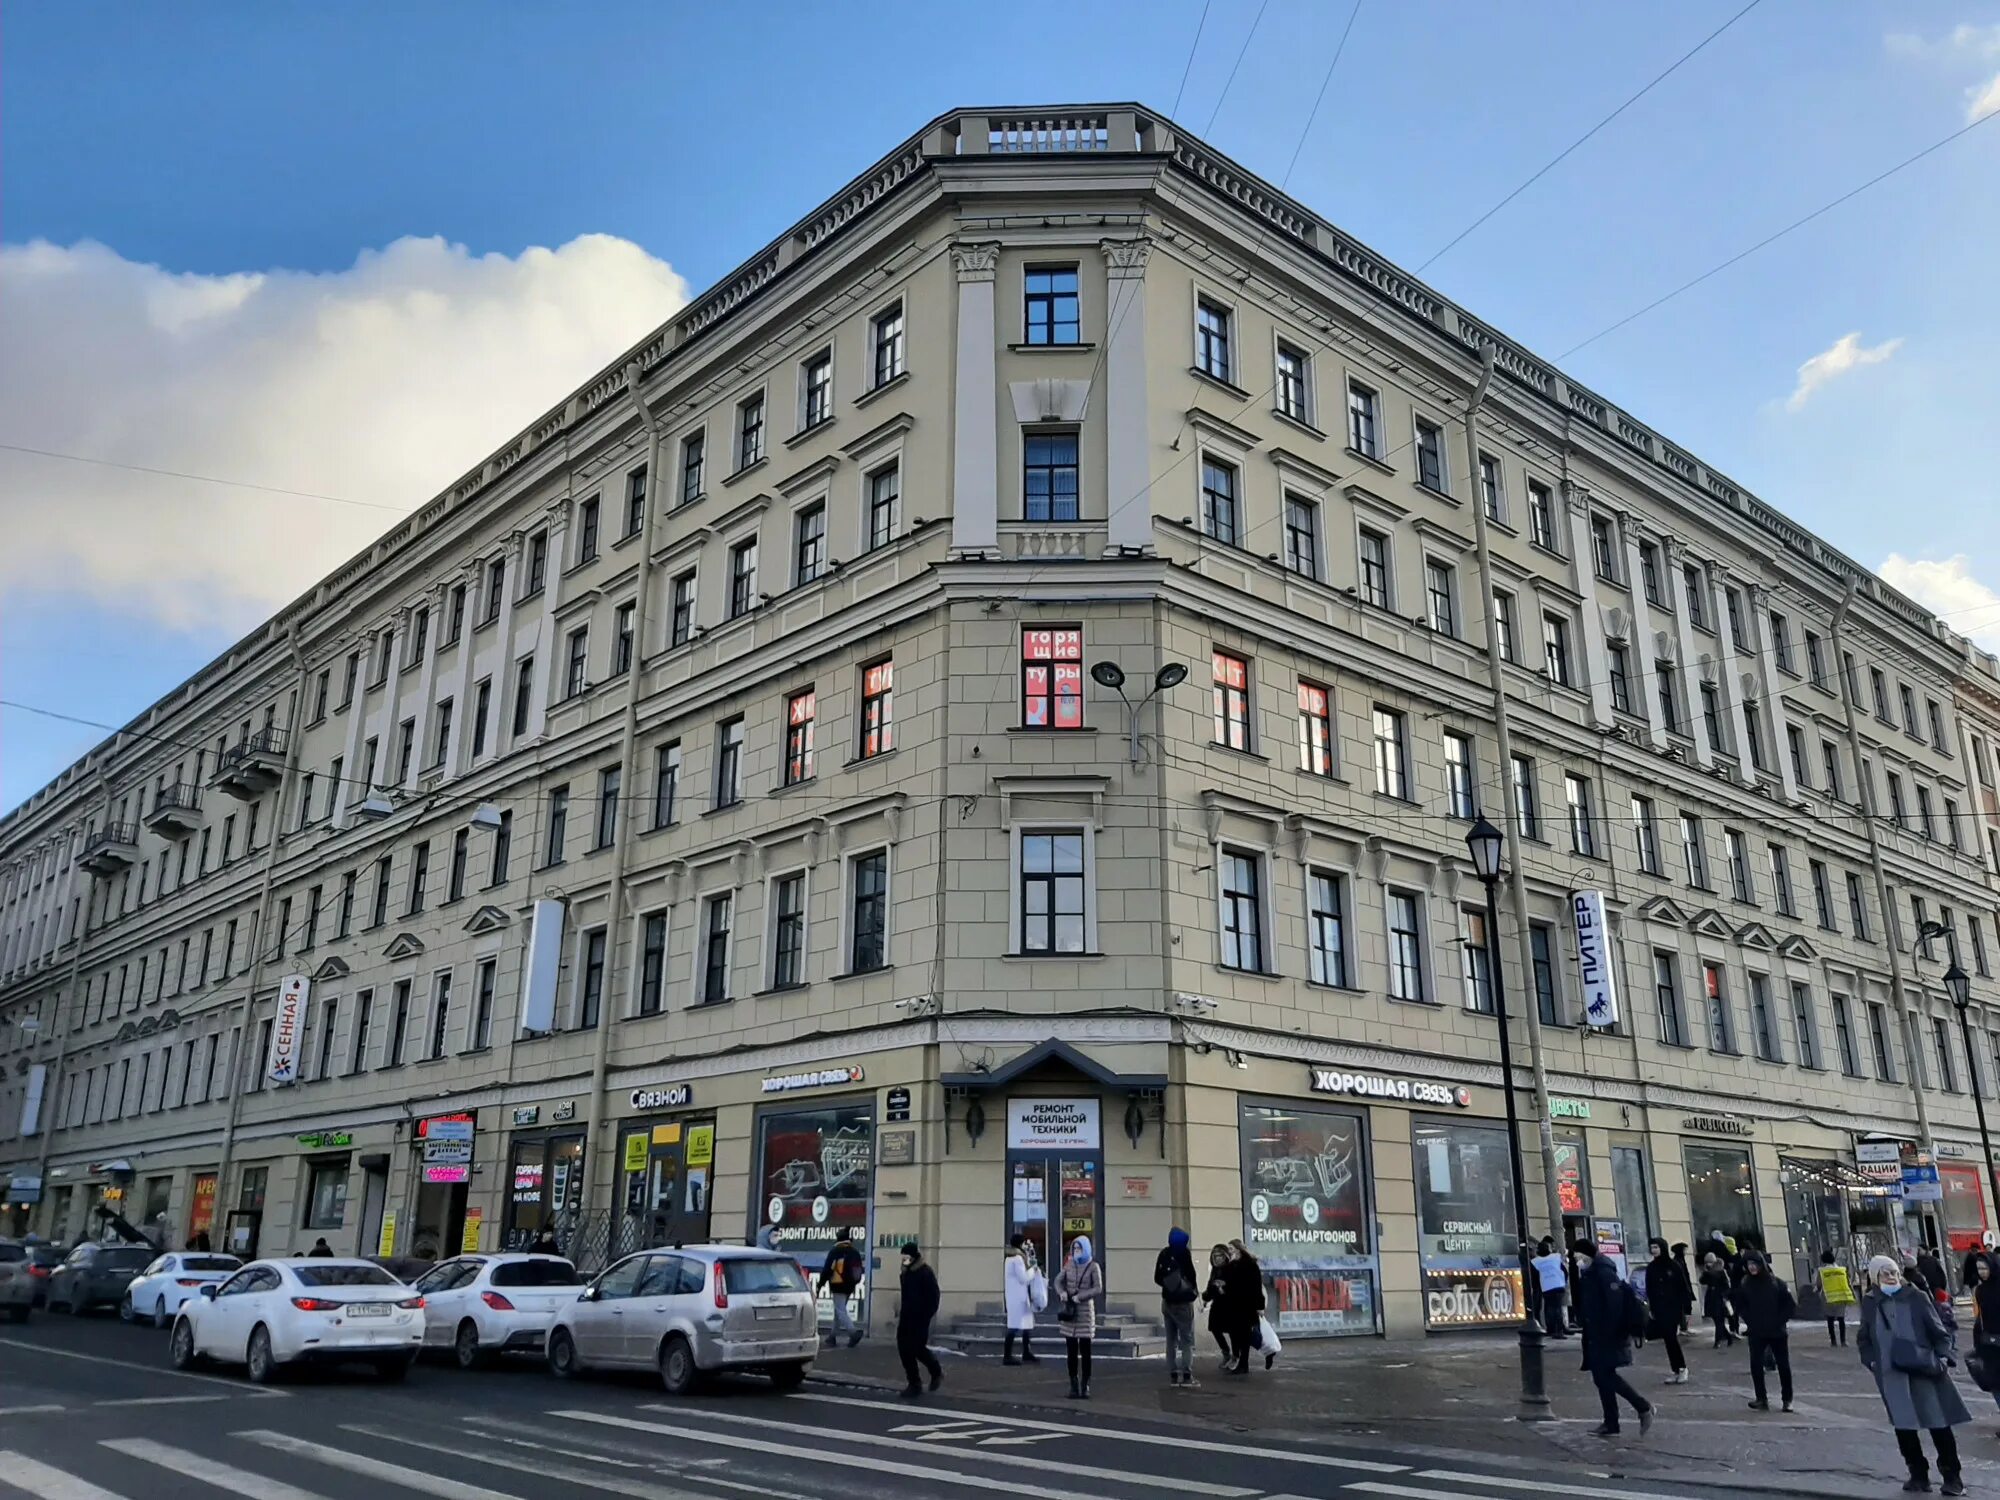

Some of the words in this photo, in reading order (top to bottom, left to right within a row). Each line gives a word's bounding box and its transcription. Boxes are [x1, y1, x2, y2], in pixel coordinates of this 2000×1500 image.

[1027, 667, 1081, 683] туры
[1575, 896, 1599, 985] ПИТЕР
[276, 993, 298, 1056] СЕННАЯ
[761, 1072, 818, 1092] ХОРОШАЯ
[819, 1068, 850, 1085] СВЯЗЬ
[1316, 1070, 1410, 1099] ХОРОШАЯ
[1413, 1082, 1454, 1104] СВЯЗЬ
[1033, 1104, 1074, 1114] РЕМОНТ
[1021, 1113, 1087, 1124] МОБИЛЬНОЙ
[1031, 1125, 1077, 1134] ТЕХНИКИ
[1860, 1164, 1897, 1175] РАЦИИ
[1072, 1220, 1085, 1229] 50
[1443, 1220, 1492, 1233] СЕРВИСНЫЙ
[779, 1227, 806, 1240] ЕМОНТ
[1251, 1228, 1291, 1241] РЕМОНТ
[1292, 1229, 1357, 1243] СМАРТФОНОВ
[1444, 1239, 1471, 1252] ЦЕНТР
[1428, 1283, 1482, 1316] cofix
